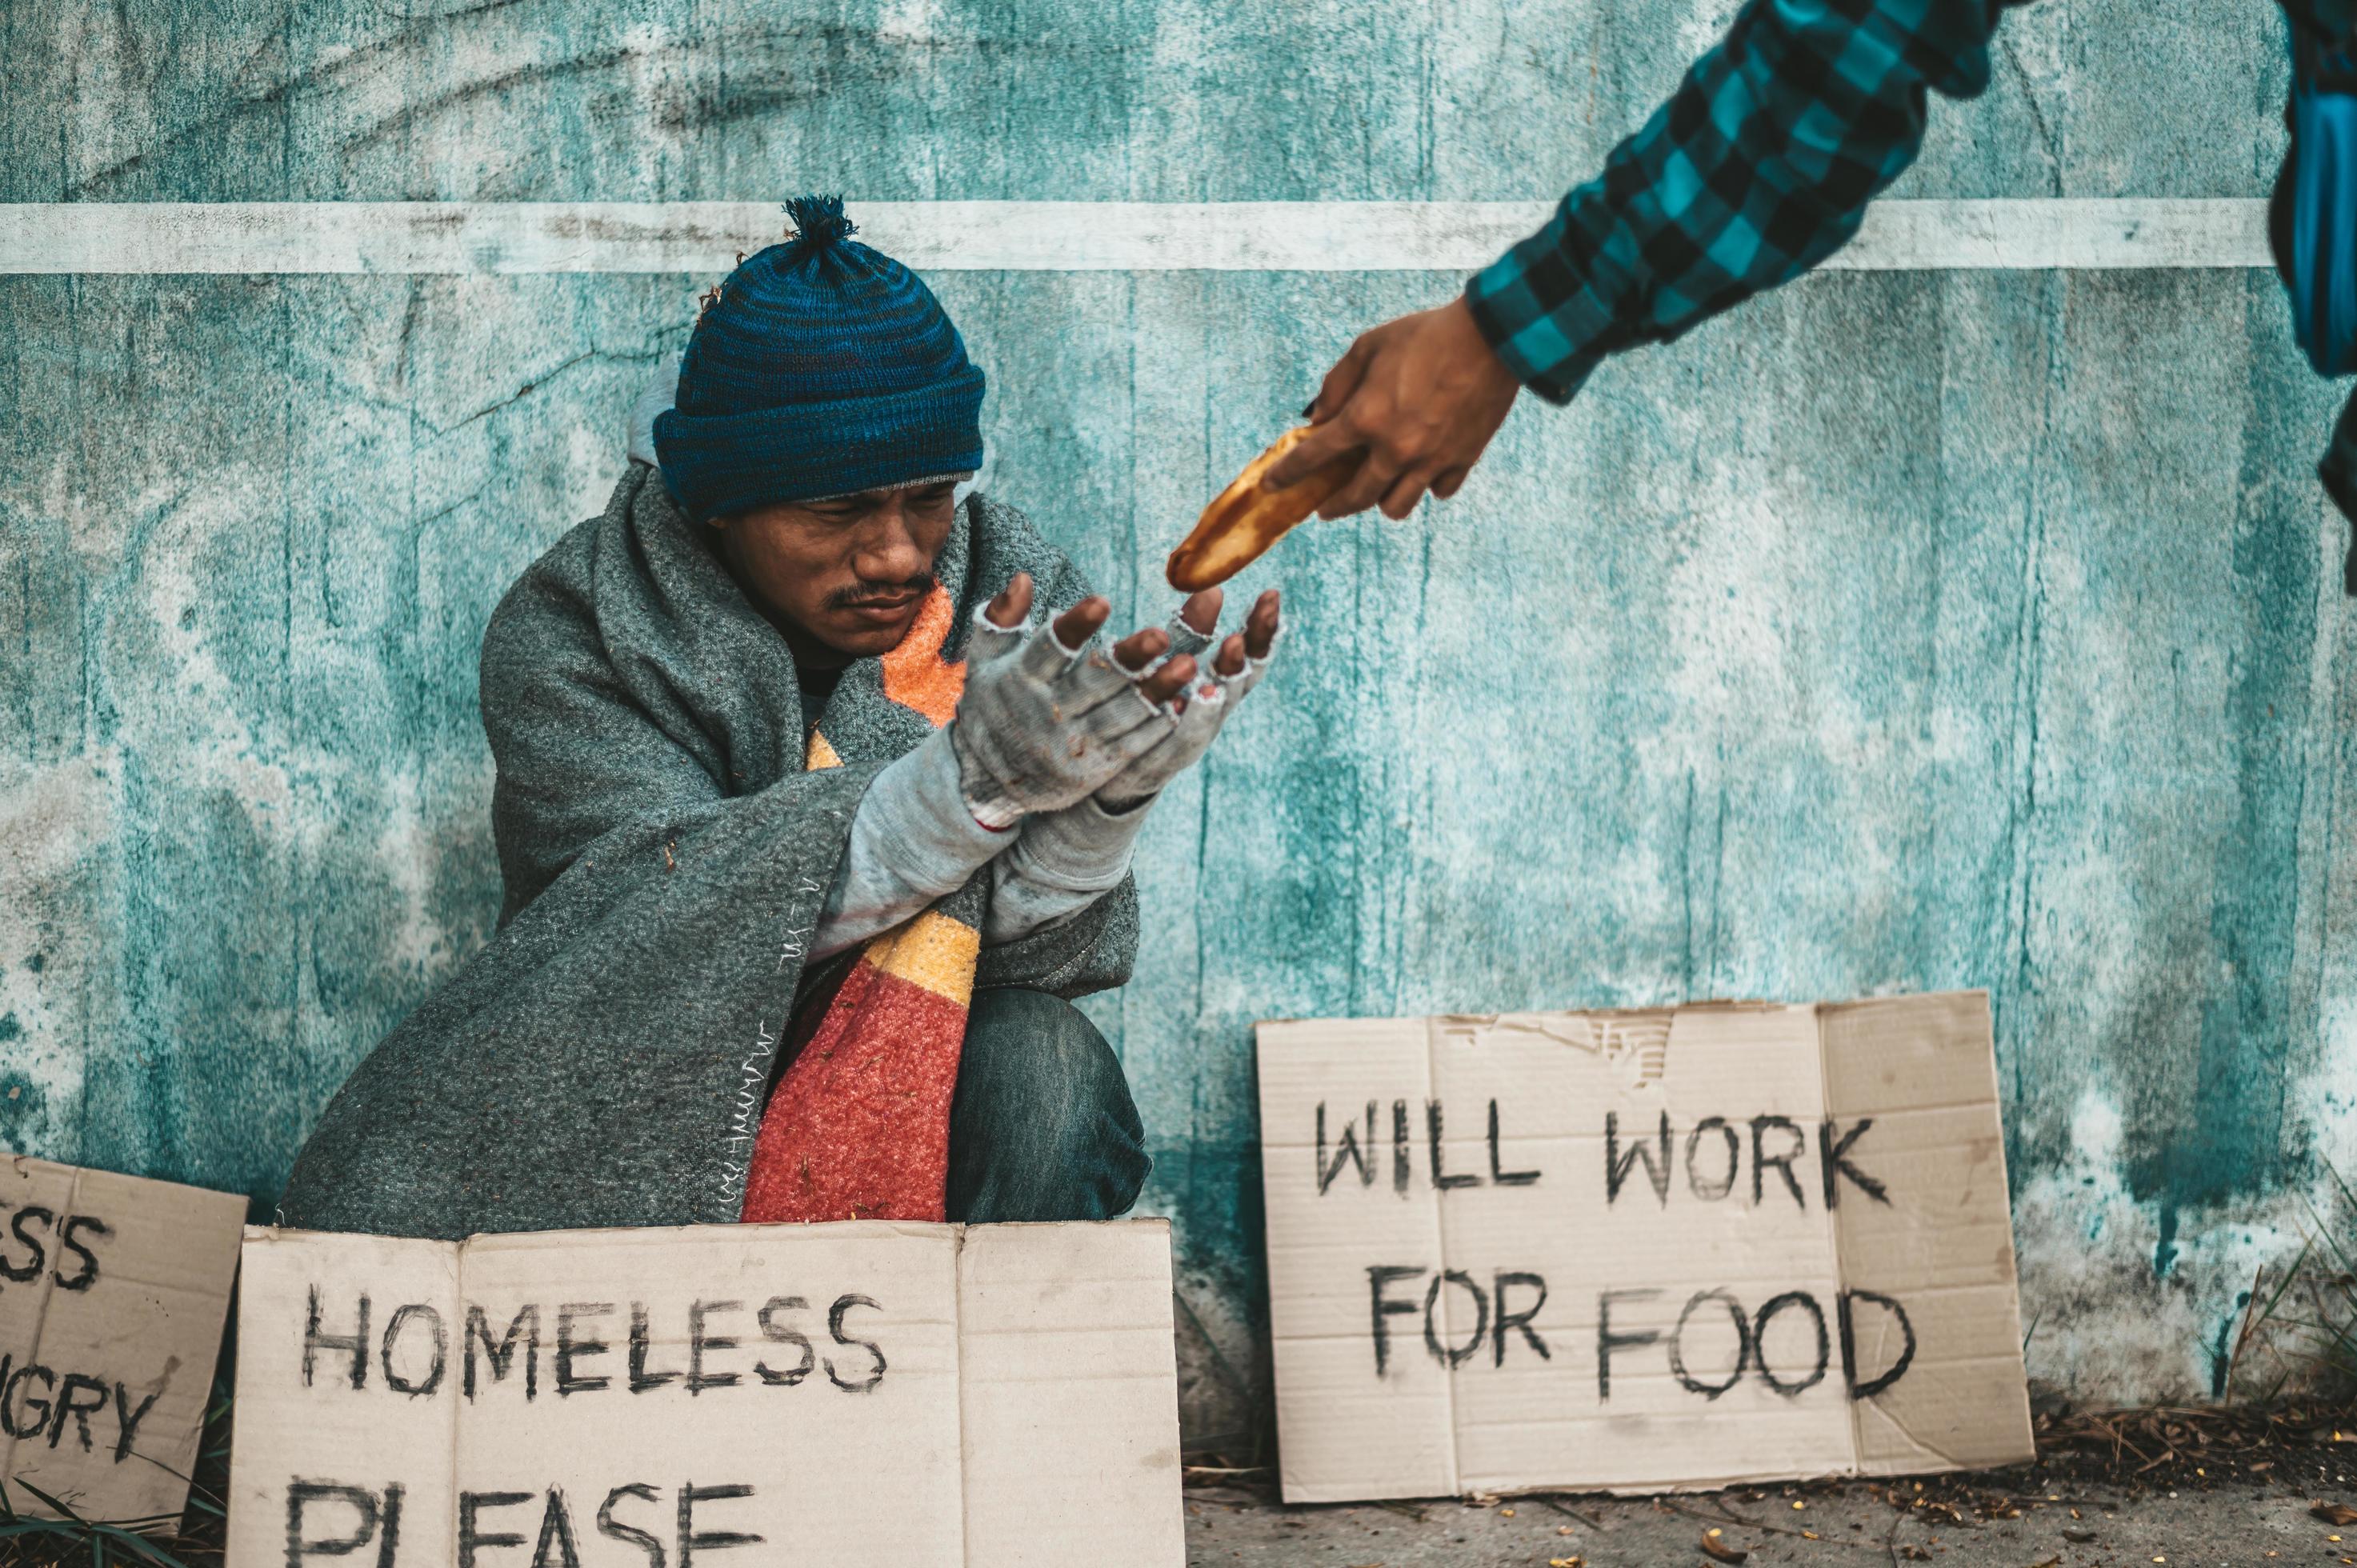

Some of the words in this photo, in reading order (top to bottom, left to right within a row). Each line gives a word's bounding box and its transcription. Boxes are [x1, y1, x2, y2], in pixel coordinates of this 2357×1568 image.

[1315, 1097, 1542, 1200] WILL
[1605, 1107, 1891, 1212] WORK
[0, 1204, 109, 1293] SS
[301, 1282, 888, 1404] HOMELESS
[1365, 1264, 1551, 1379] FOR
[1597, 1285, 1917, 1403] FOOD
[0, 1354, 181, 1464] GRY
